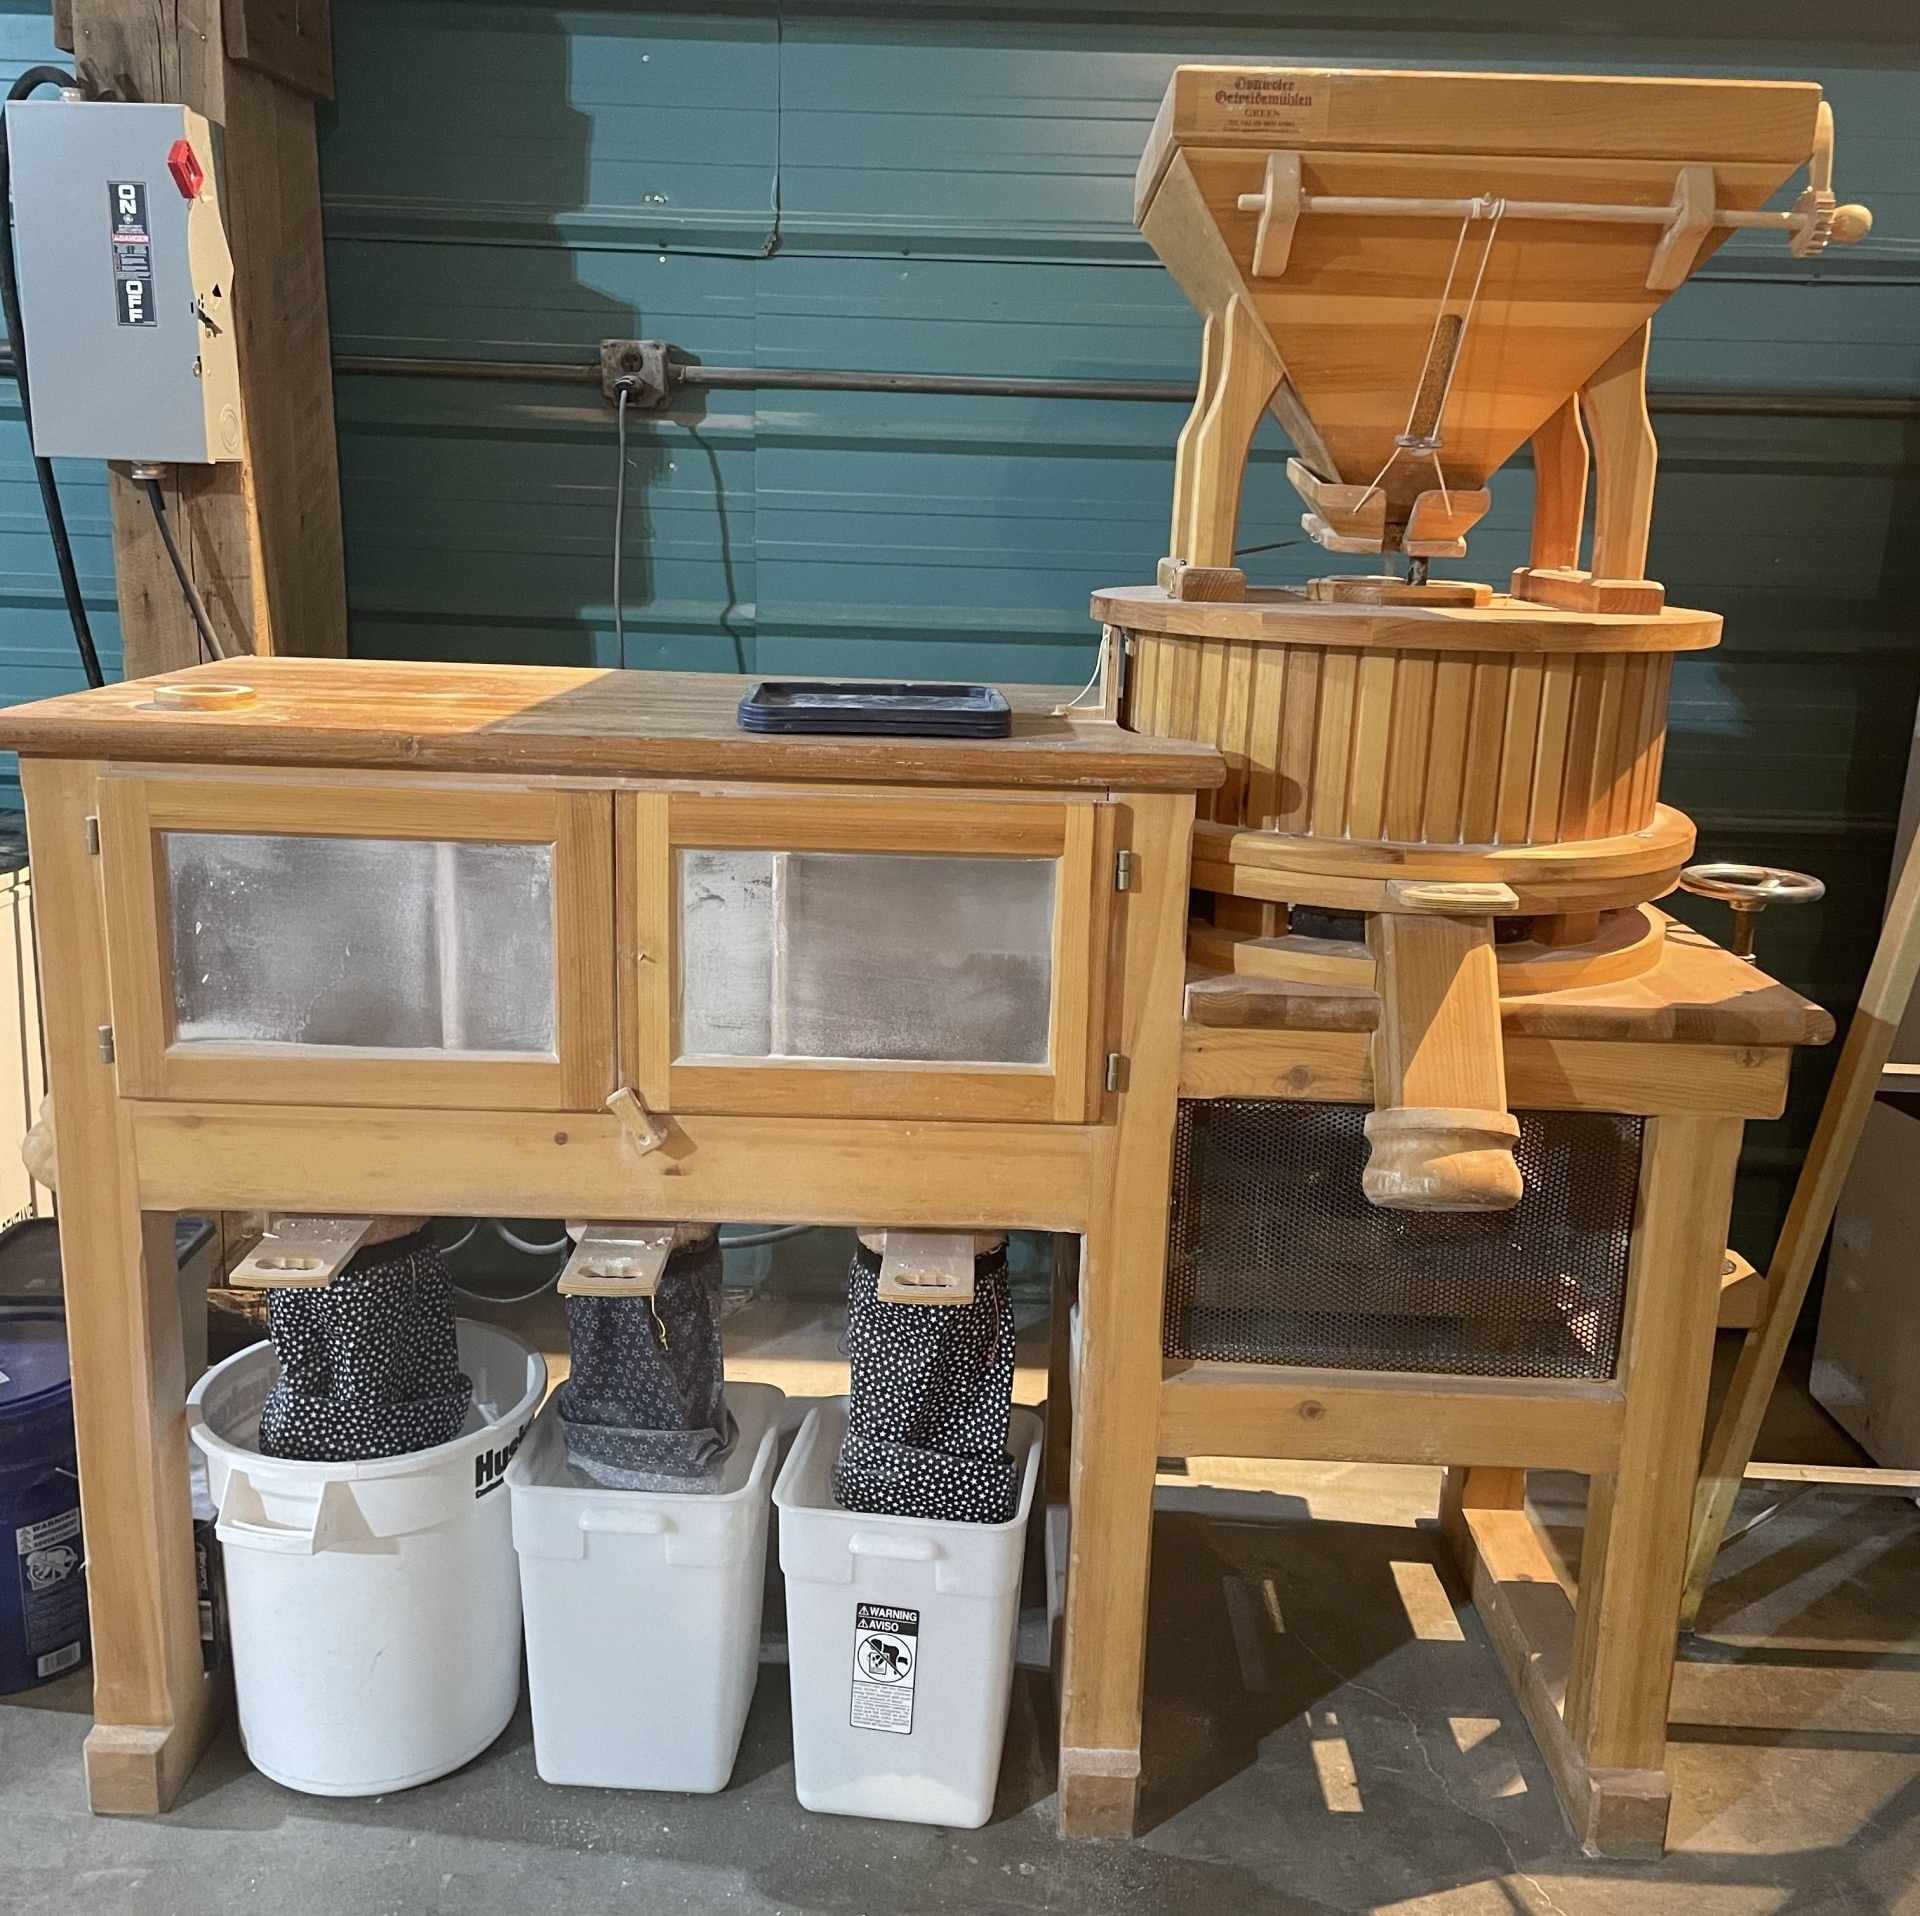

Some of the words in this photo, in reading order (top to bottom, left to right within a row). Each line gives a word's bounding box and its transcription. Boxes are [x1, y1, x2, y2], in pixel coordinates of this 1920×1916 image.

[117, 184, 137, 214] ON
[125, 280, 143, 323] OFF
[869, 1606, 917, 1621] WARNING
[869, 1618, 899, 1632] AVISO
